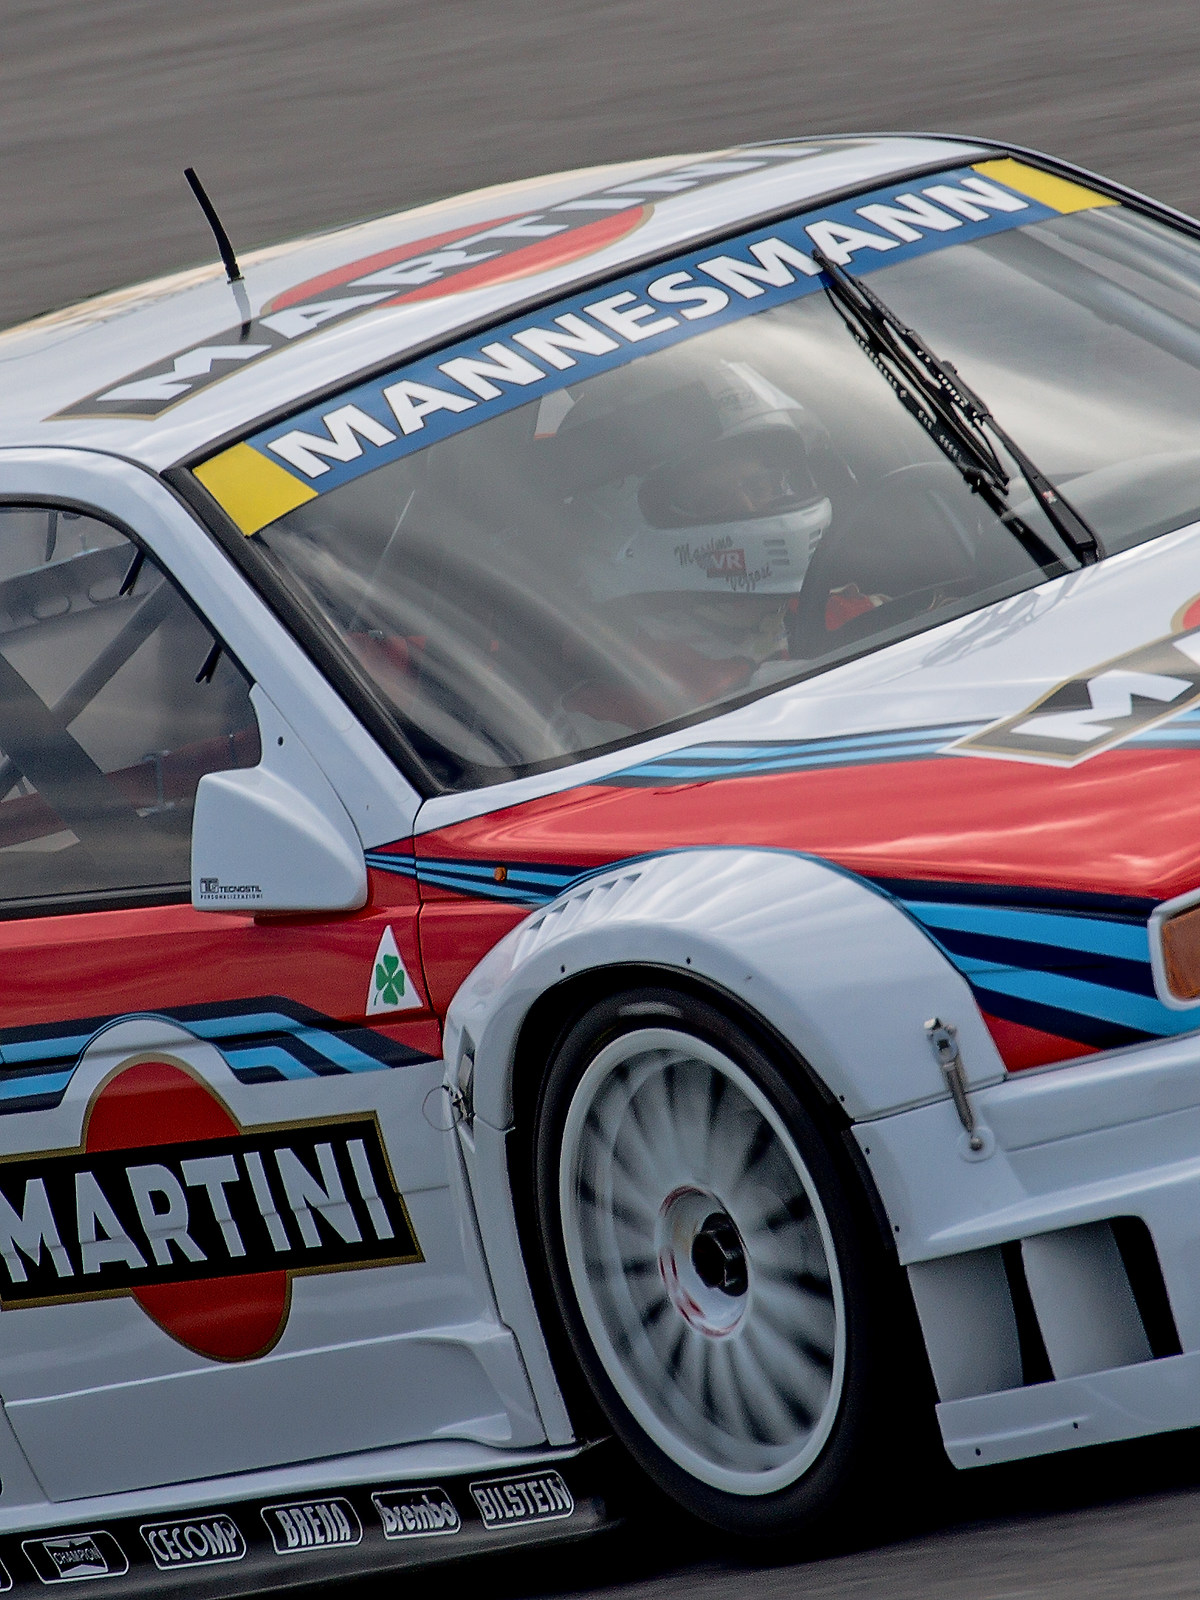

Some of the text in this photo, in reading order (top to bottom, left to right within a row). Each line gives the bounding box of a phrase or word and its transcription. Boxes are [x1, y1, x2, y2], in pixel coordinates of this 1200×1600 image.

[96, 146, 822, 402] MARTINI
[266, 177, 1030, 479] MANNESMANN
[0, 1137, 396, 1285] MARTINI
[373, 1494, 458, 1533] brembo
[473, 1477, 570, 1520] BILSTEIN
[53, 1546, 101, 1566] CHAMPION
[148, 1521, 237, 1562] CECOMP
